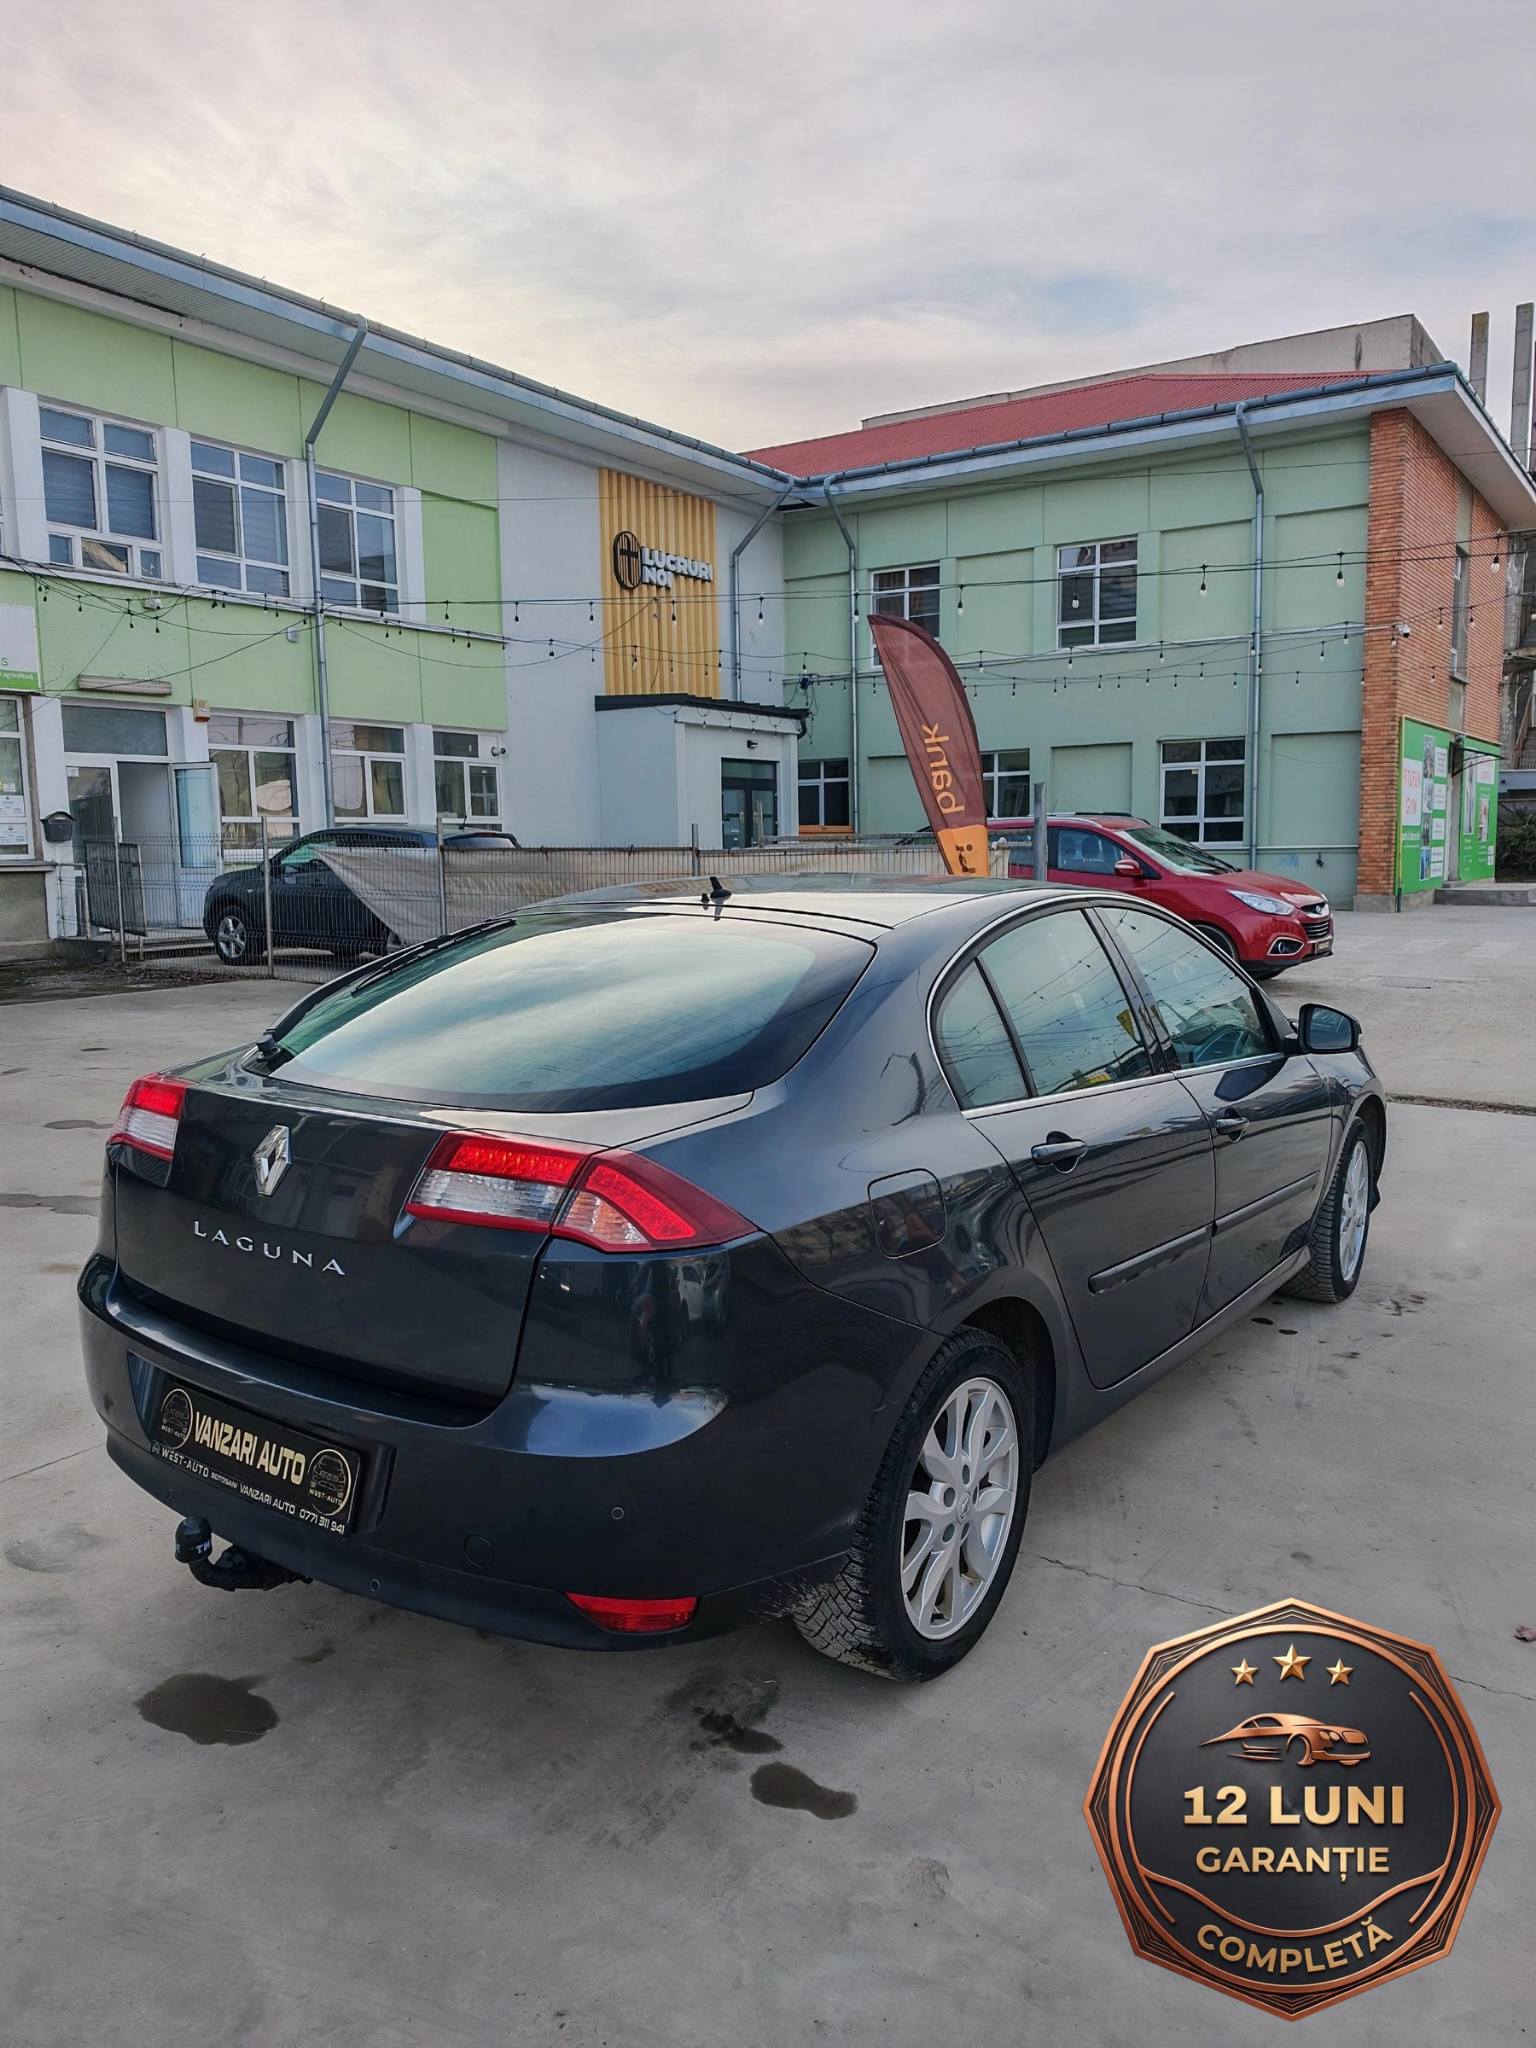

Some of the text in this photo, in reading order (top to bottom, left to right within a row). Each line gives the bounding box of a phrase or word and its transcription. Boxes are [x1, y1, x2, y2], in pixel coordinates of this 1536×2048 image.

[641, 566, 673, 589] NOI
[194, 1221, 345, 1275] LAGUNA
[194, 1411, 306, 1485] VANZARI AUTO
[161, 1447, 209, 1478] WEST-AUTO
[240, 1483, 272, 1505] VANZARI
[272, 1498, 296, 1515] AUTO
[299, 1508, 318, 1524] 0771
